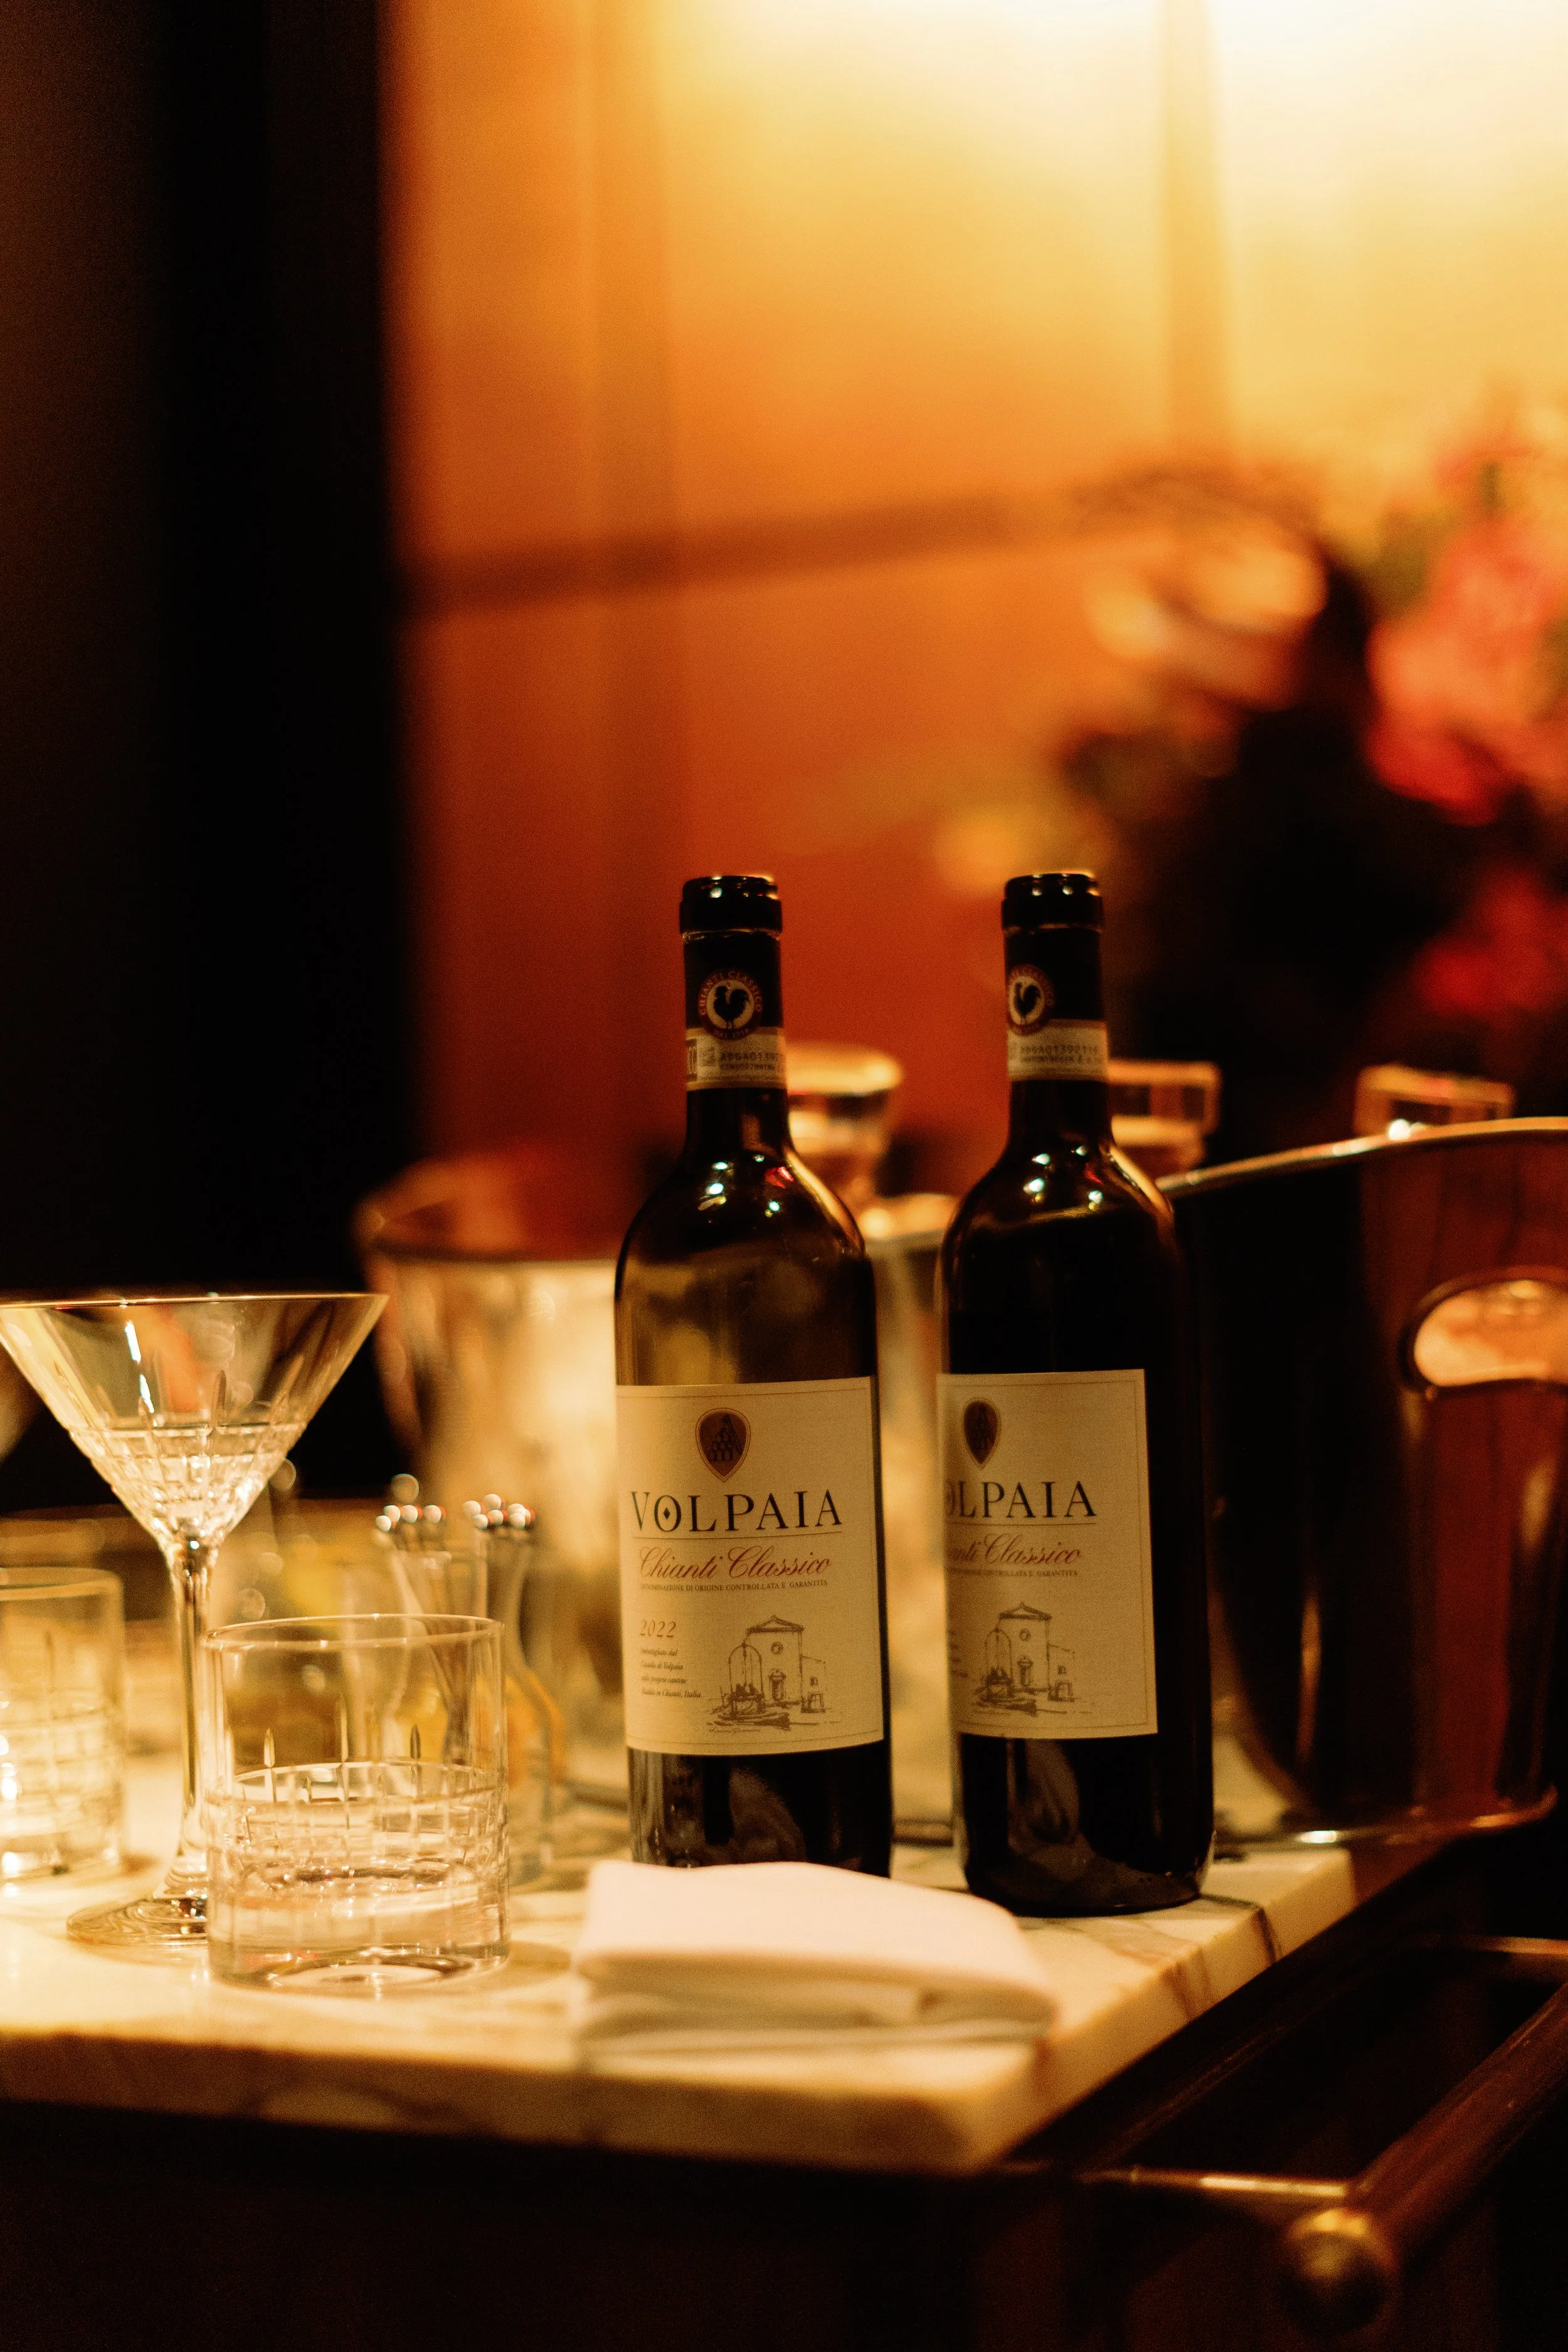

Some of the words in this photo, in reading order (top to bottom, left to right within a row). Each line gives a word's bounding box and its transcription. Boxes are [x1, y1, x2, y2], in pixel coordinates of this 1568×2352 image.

[699, 972, 725, 1016] CHIANTI
[728, 970, 763, 1012] CLASSICO
[630, 1489, 843, 1532] VOLPAIA
[640, 1546, 723, 1579] Chianti
[728, 1545, 832, 1579] Classico
[983, 1532, 1083, 1564] Classico
[694, 1584, 724, 1592] ORIGINE
[726, 1582, 780, 1591] CONTROLLATA
[789, 1579, 828, 1588] GARANTITA
[640, 1619, 676, 1638] 2022
